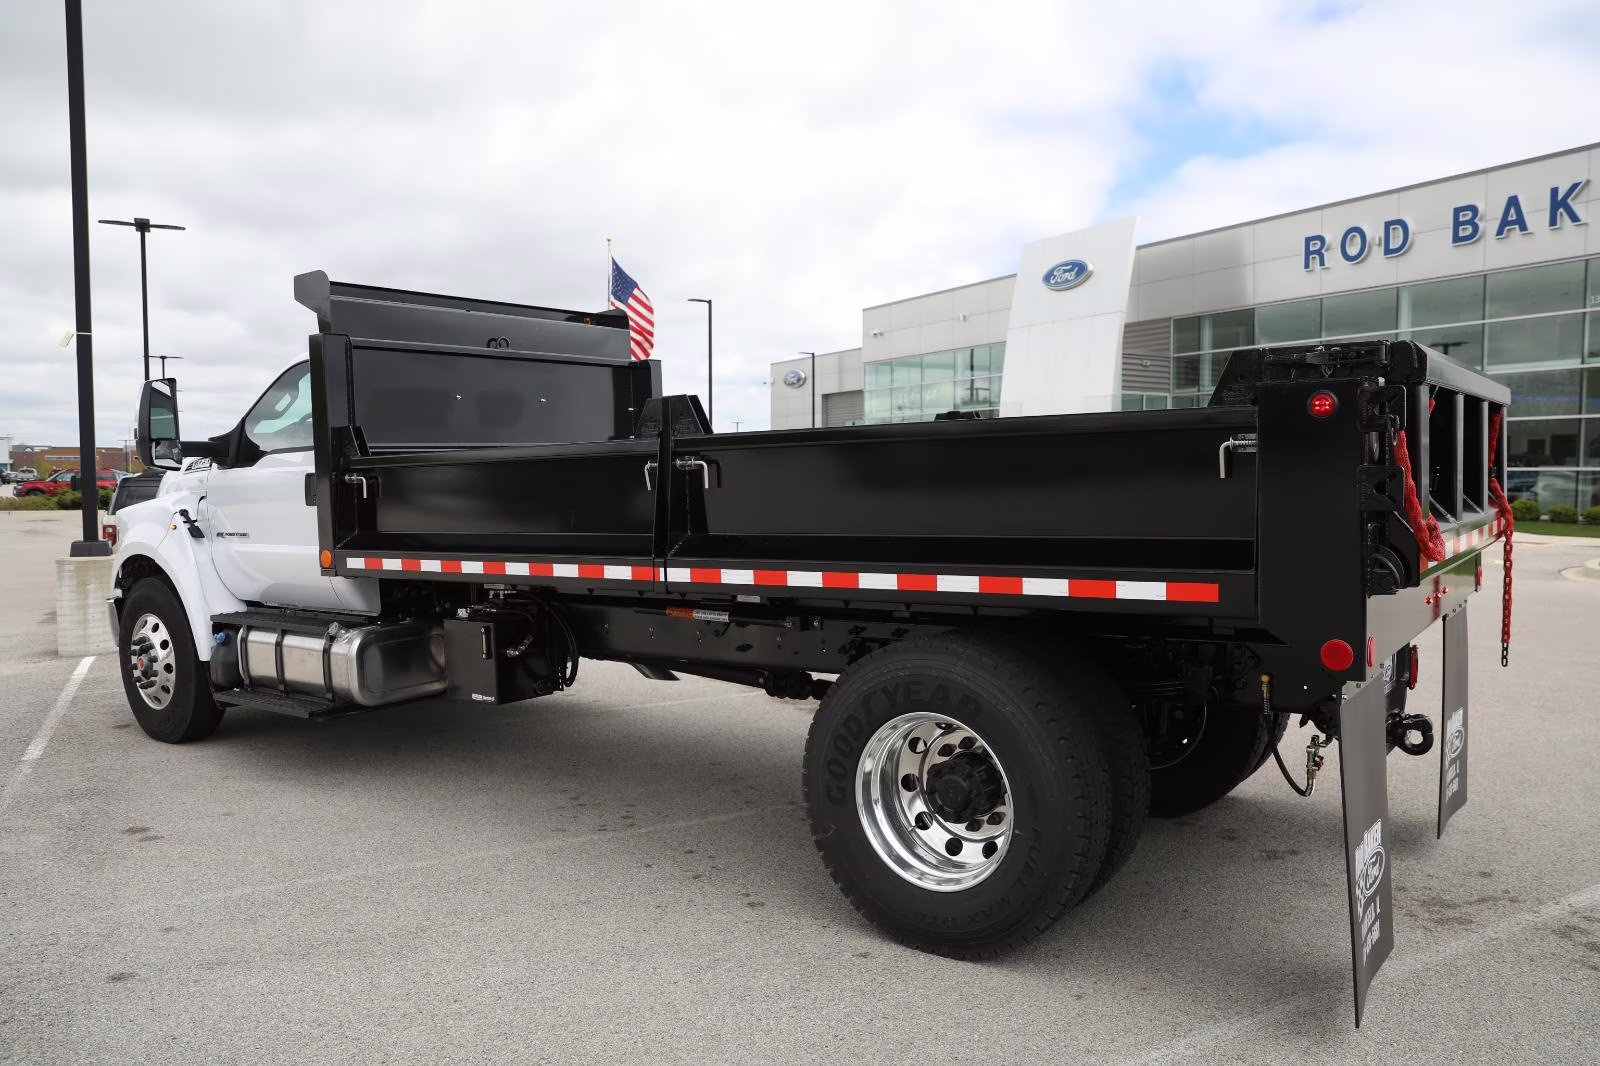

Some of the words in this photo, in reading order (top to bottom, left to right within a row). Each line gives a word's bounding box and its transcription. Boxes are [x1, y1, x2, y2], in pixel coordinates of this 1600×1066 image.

[1303, 217, 1412, 272] ROD
[1451, 179, 1591, 248] BAK
[825, 680, 984, 809] GOODYEAR
